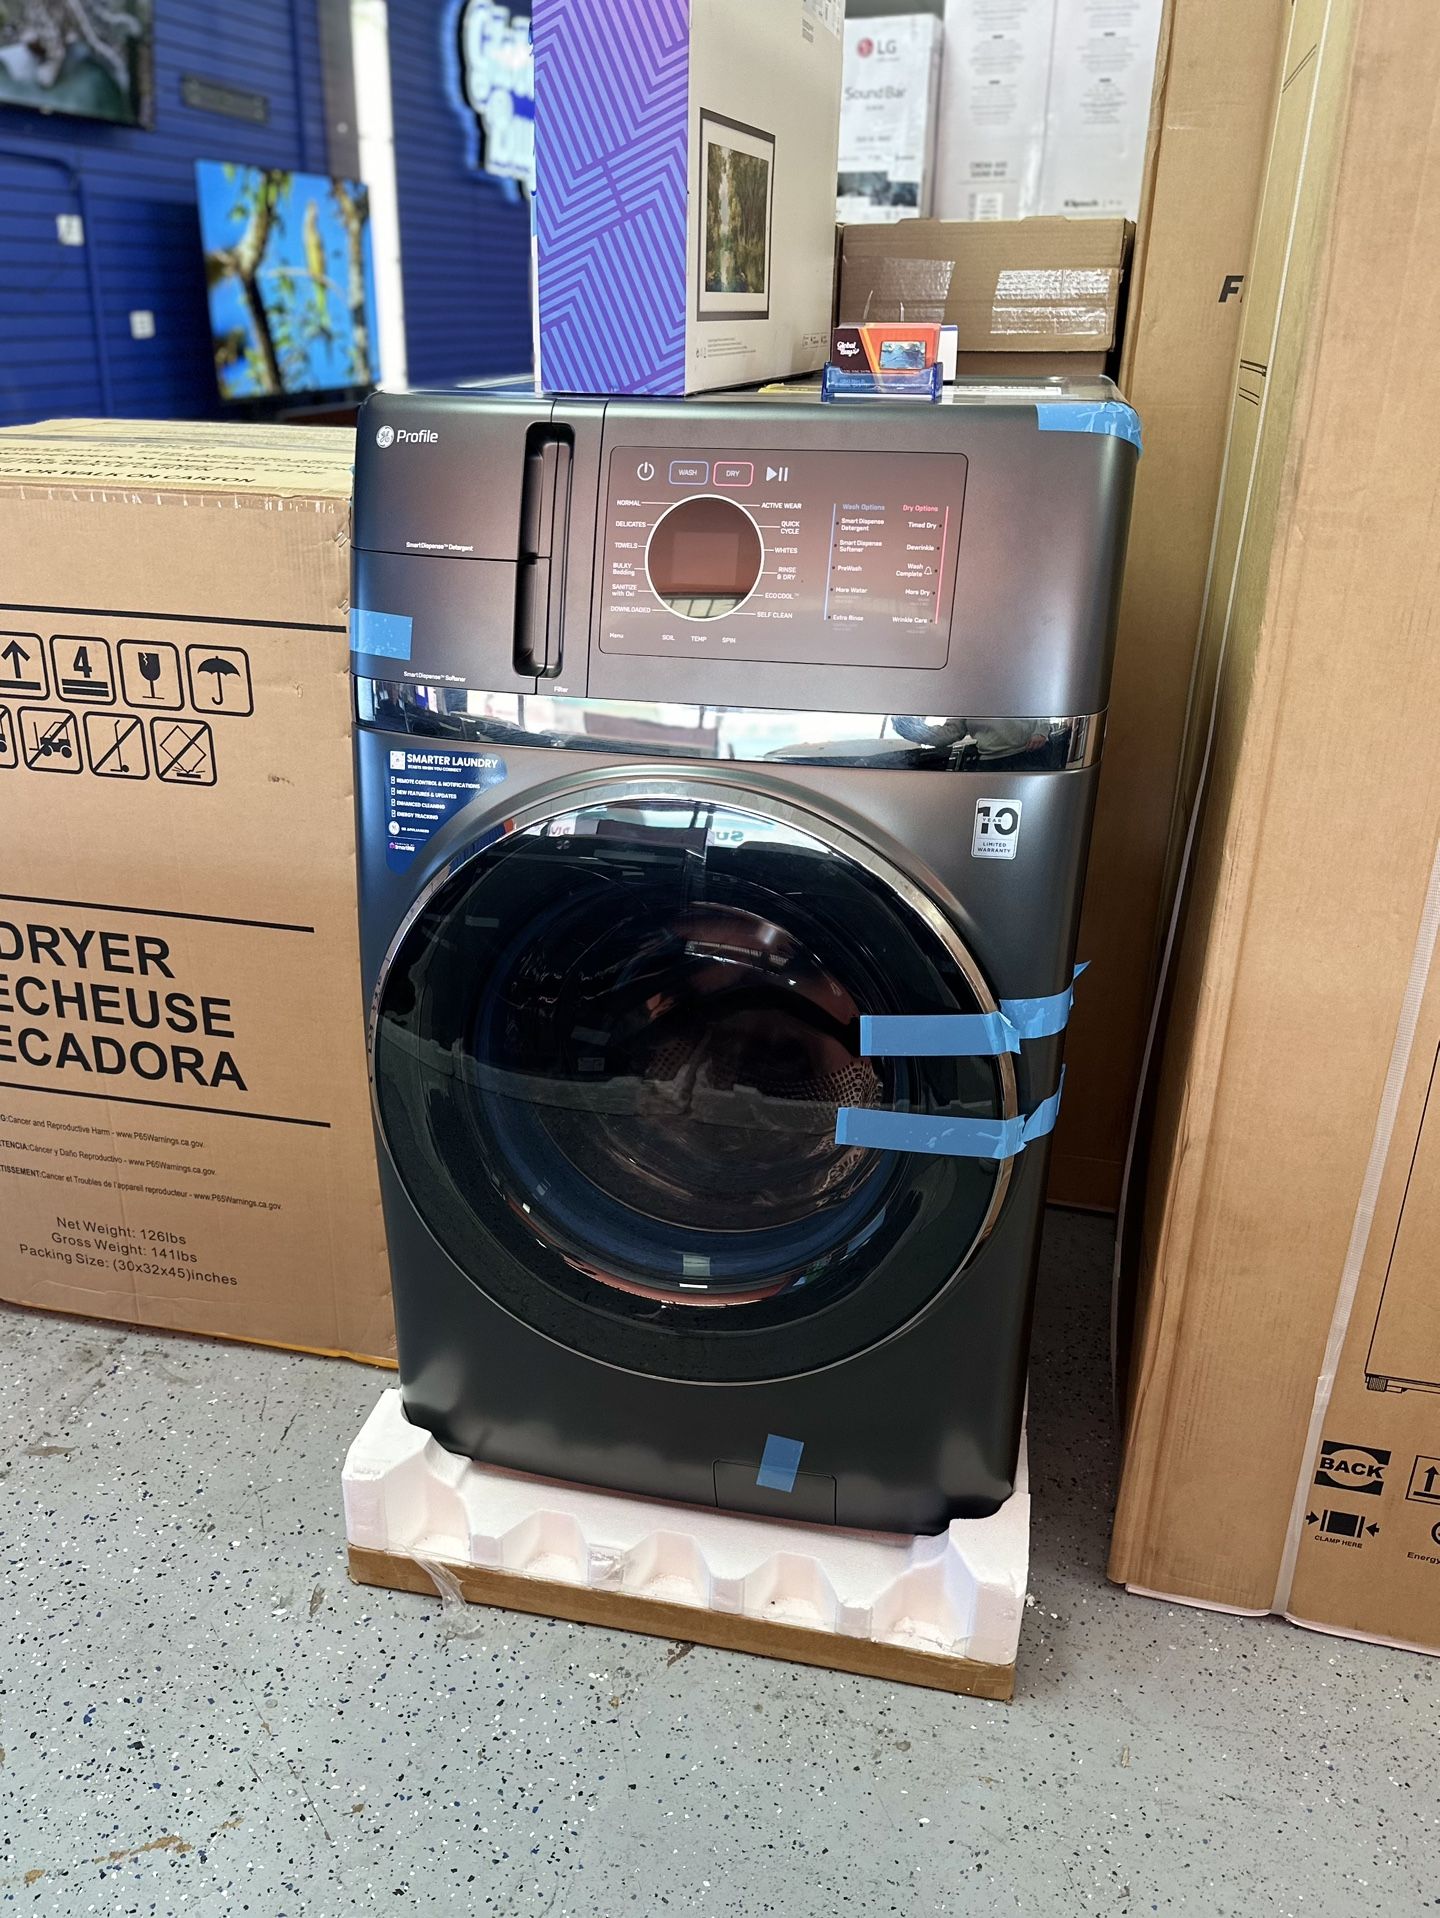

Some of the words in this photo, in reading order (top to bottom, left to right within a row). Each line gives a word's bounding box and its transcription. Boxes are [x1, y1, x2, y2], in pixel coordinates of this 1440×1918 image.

[877, 40, 897, 54] LG
[1218, 275, 1244, 303] F
[837, 341, 857, 350] Global
[396, 429, 439, 444] Profile
[616, 499, 641, 507] NORMAL
[861, 504, 885, 512] Options
[915, 505, 939, 513] Options
[781, 520, 800, 528] QUICK
[926, 522, 936, 530] Dry
[449, 543, 473, 552] Detergent
[613, 562, 632, 570] BULKY
[613, 568, 635, 576] Bedding
[920, 589, 930, 597] Dry
[691, 635, 707, 643] TEMP
[72, 646, 93, 678] 4
[445, 674, 466, 682] Softener
[554, 685, 568, 693] Filter
[406, 753, 451, 765] SMARTER
[452, 757, 498, 768] LAUNDRY
[415, 779, 437, 787] CONTROL
[443, 781, 480, 789] NOTIFICATIONS
[435, 792, 457, 800] UPDATES
[396, 800, 421, 808] ENHANCED
[421, 802, 445, 810] CLEANING
[977, 806, 1019, 836] 10
[0, 921, 176, 978] DRYER
[33, 1120, 45, 1128] and
[46, 1121, 90, 1133] Reproductive
[91, 1126, 110, 1136] Harm
[59, 1149, 77, 1158] Daño
[79, 1151, 122, 1163] Reproductivo
[66, 1175, 73, 1183] et
[73, 1175, 102, 1187] Troubles
[103, 1180, 112, 1188] de
[144, 1185, 187, 1198] reproducteur
[56, 1216, 80, 1231] Net
[84, 1219, 136, 1239] Weight:
[140, 1228, 187, 1245] 126lbs
[51, 1232, 91, 1248] Gross
[95, 1237, 147, 1256] Weight:
[151, 1246, 198, 1264] 141lbs
[20, 1243, 72, 1265] Packing
[76, 1252, 109, 1268] Size:
[113, 1257, 238, 1287] (30x32x45)inches
[1319, 1457, 1385, 1479] BACK
[1314, 1535, 1341, 1545] CLAMP
[1342, 1539, 1363, 1549] HERE
